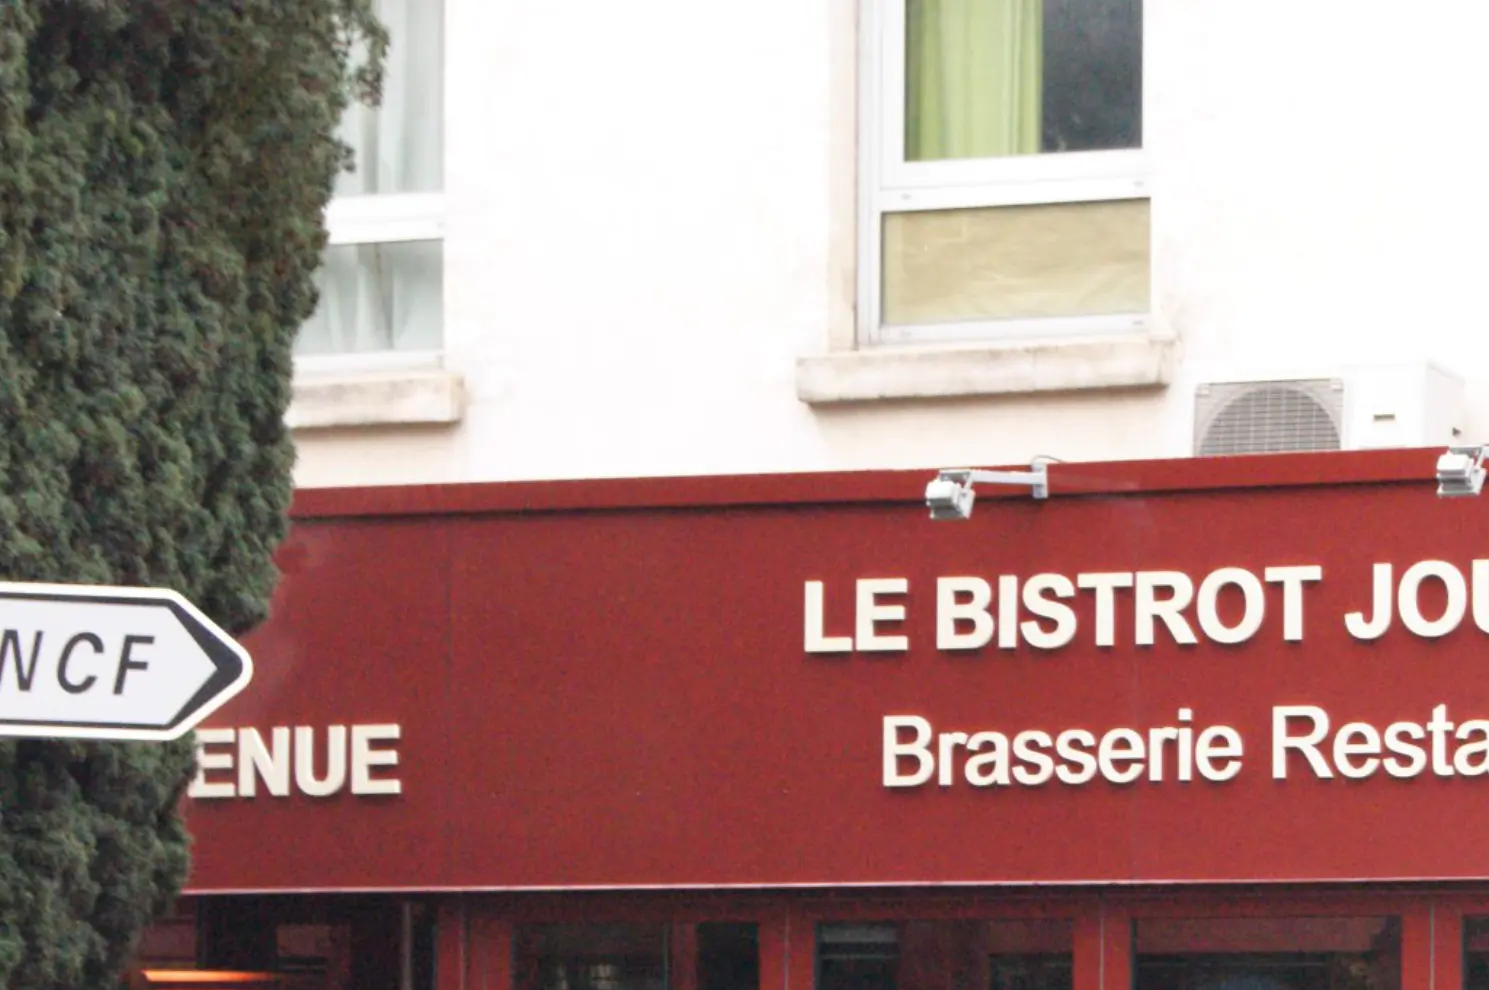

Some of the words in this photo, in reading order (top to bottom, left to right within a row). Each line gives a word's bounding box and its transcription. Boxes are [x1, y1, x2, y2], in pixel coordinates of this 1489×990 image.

[803, 578, 909, 656] LE
[935, 565, 1325, 652] BISTROT
[881, 706, 1246, 790] Brasserie
